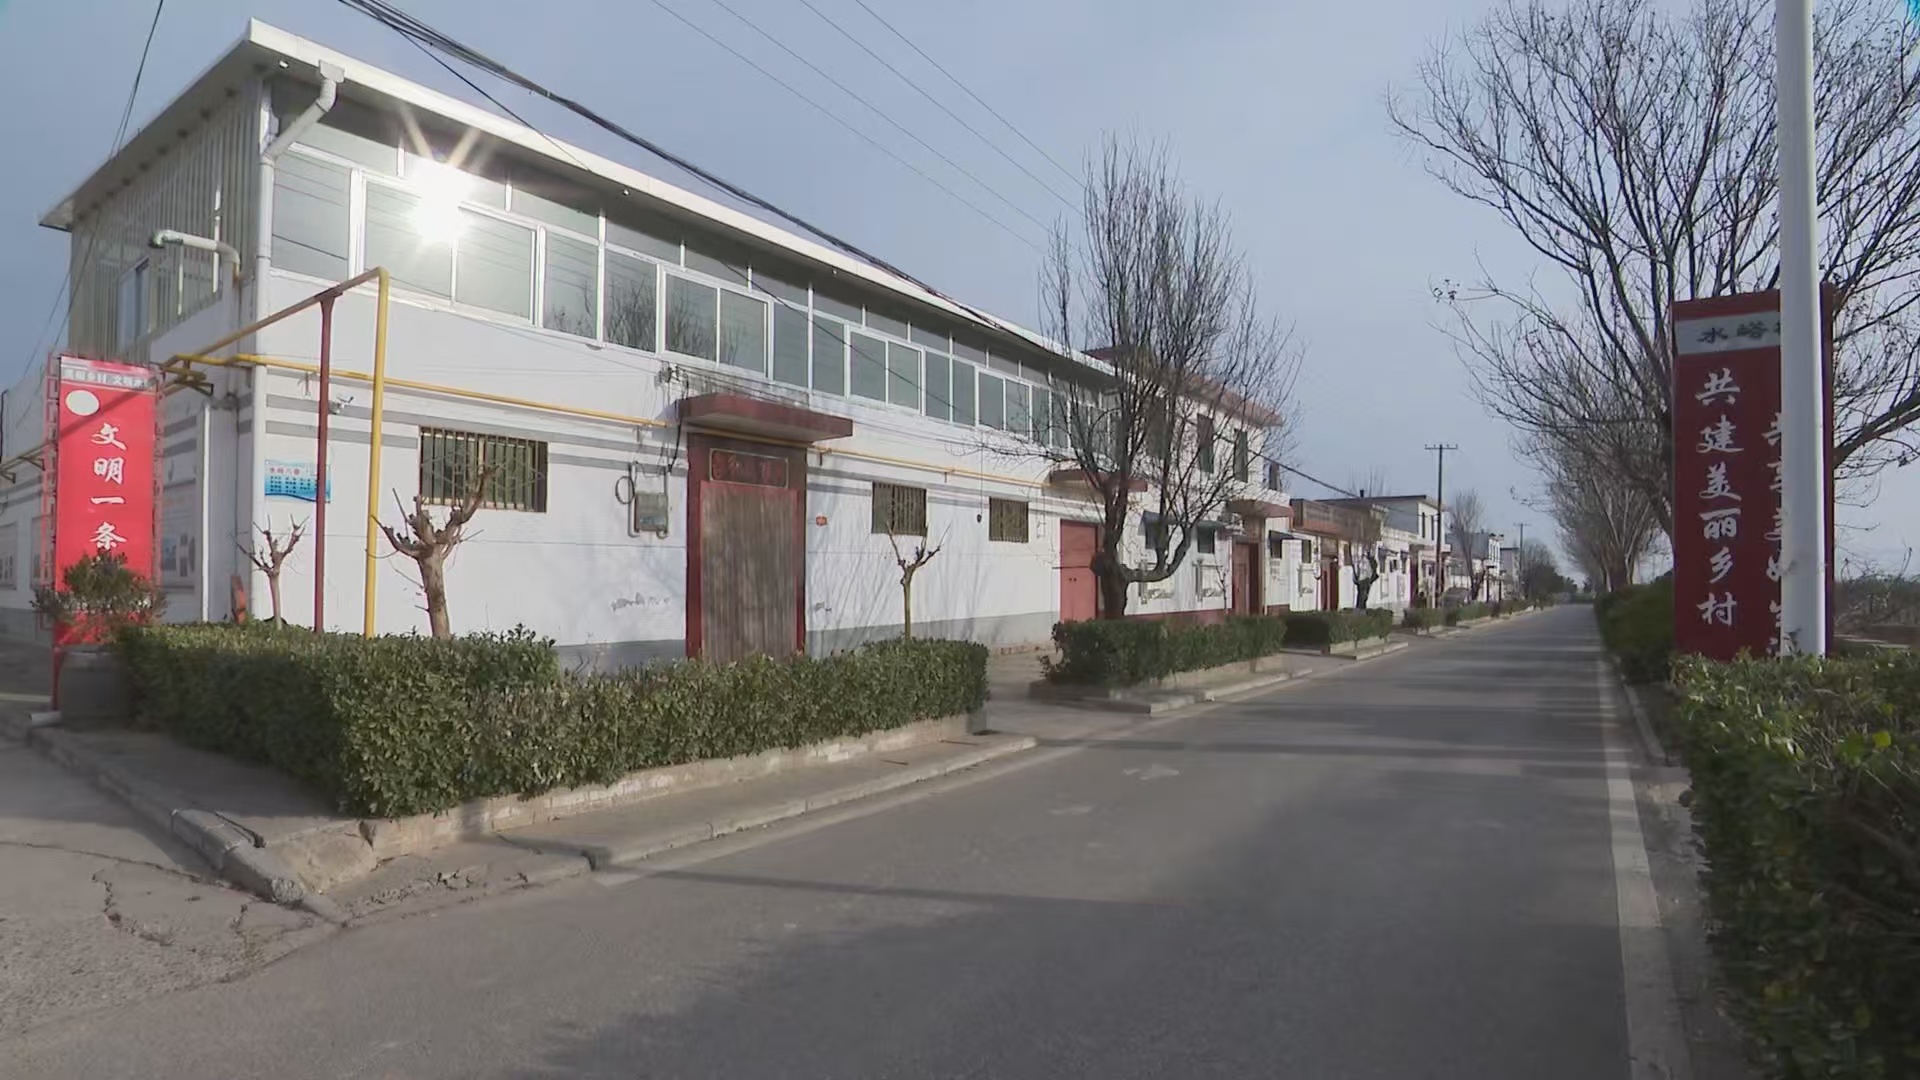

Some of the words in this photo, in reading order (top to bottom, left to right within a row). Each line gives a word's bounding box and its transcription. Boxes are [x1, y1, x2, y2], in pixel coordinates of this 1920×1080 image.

[1696, 320, 1781, 344] 水峪
[1695, 367, 1744, 627] 共建美丽乡村
